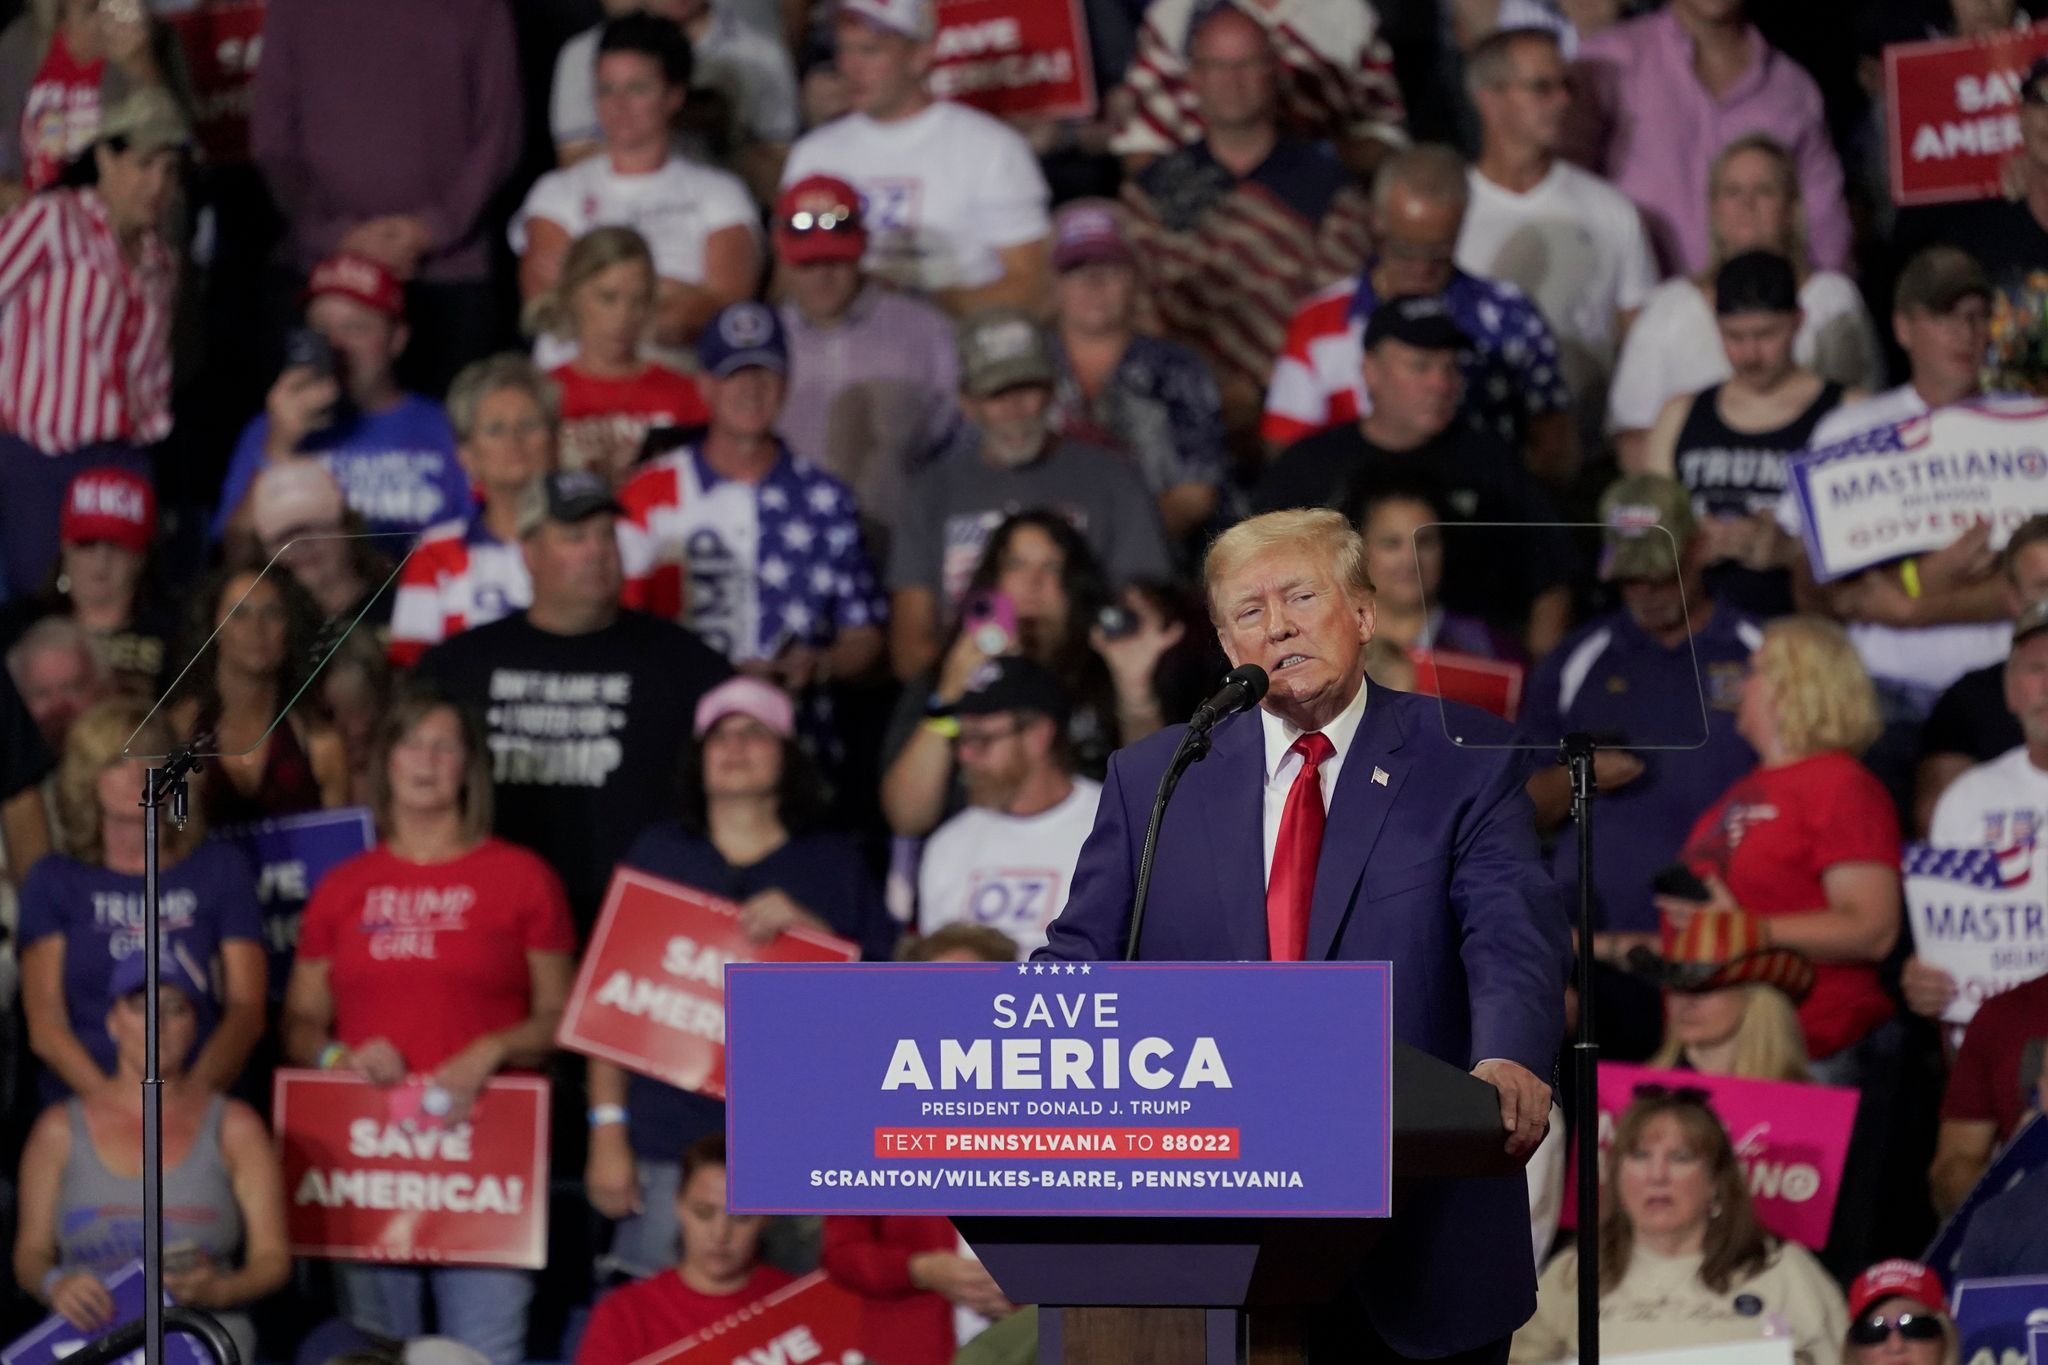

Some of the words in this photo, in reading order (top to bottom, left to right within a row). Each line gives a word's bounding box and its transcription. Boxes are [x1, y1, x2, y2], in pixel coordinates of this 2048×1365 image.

[1829, 447, 2047, 507] MASTRIANO
[72, 479, 144, 524] MAGA
[601, 672, 631, 704] ME
[487, 733, 622, 786] TRUMP
[361, 885, 476, 924] TRUMP
[970, 882, 1042, 922] OZ
[369, 931, 437, 960] GIRL
[661, 935, 725, 990] SA
[993, 993, 1119, 1029] SAVE
[881, 1037, 1233, 1090] AMERICA
[921, 1101, 1020, 1116] PRESIDENT
[1027, 1101, 1103, 1115] DONALD
[1109, 1101, 1123, 1115] J.
[1130, 1100, 1191, 1115] TRUMP
[350, 1117, 473, 1161] SAVE
[883, 1134, 936, 1150] TEXT
[945, 1134, 1116, 1151] PENNSYLVANIA
[1125, 1134, 1153, 1150] TO
[1162, 1134, 1230, 1151] 88022
[296, 1167, 523, 1213] AMERICA!
[810, 1168, 1123, 1191] SCRANTON/WILKES-BARRE,
[1131, 1170, 1304, 1188] PENNSYLVANIA
